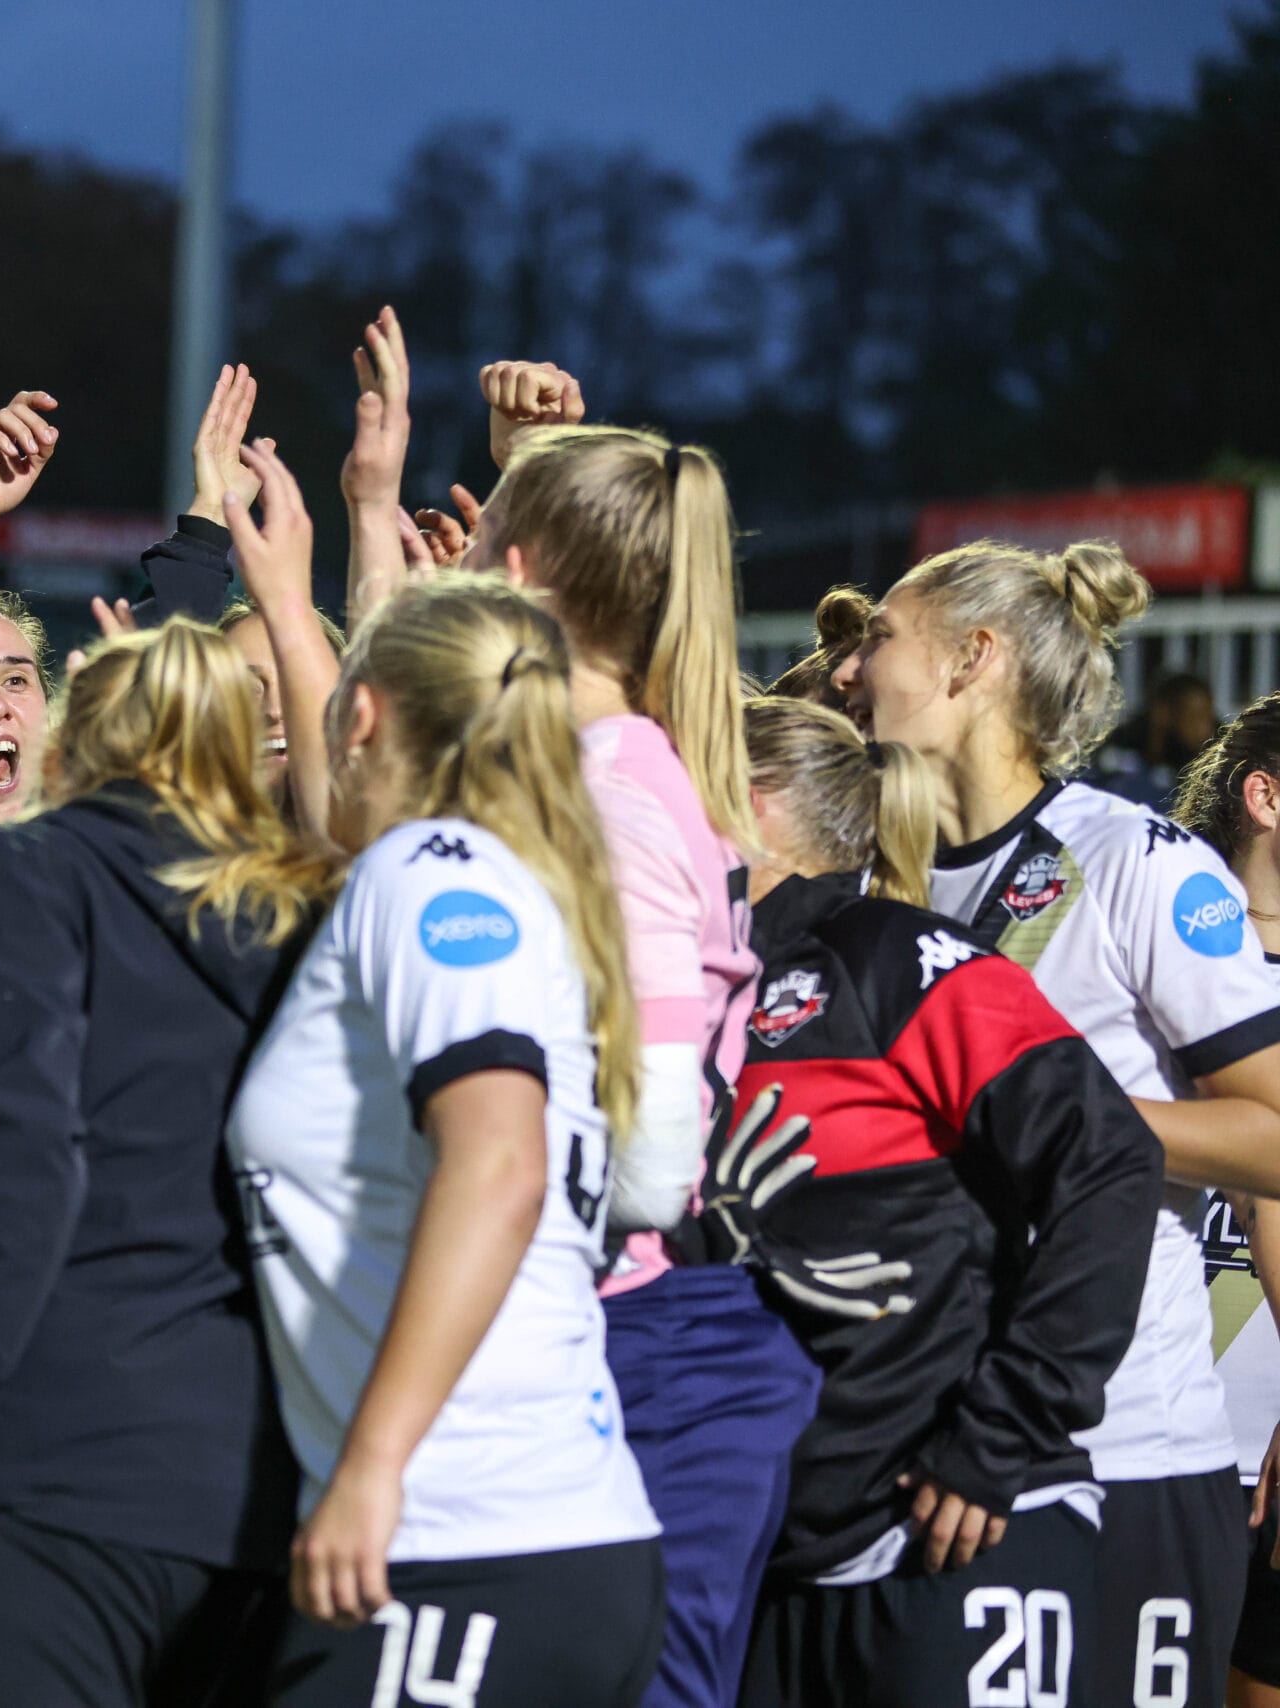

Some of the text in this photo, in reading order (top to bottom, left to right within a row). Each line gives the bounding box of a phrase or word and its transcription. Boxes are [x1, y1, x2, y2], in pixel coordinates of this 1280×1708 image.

[423, 913, 514, 947] xero
[1180, 898, 1241, 937] xero
[370, 1600, 497, 1708] 14
[964, 1586, 1073, 1708] 20
[1133, 1598, 1192, 1708] 6
